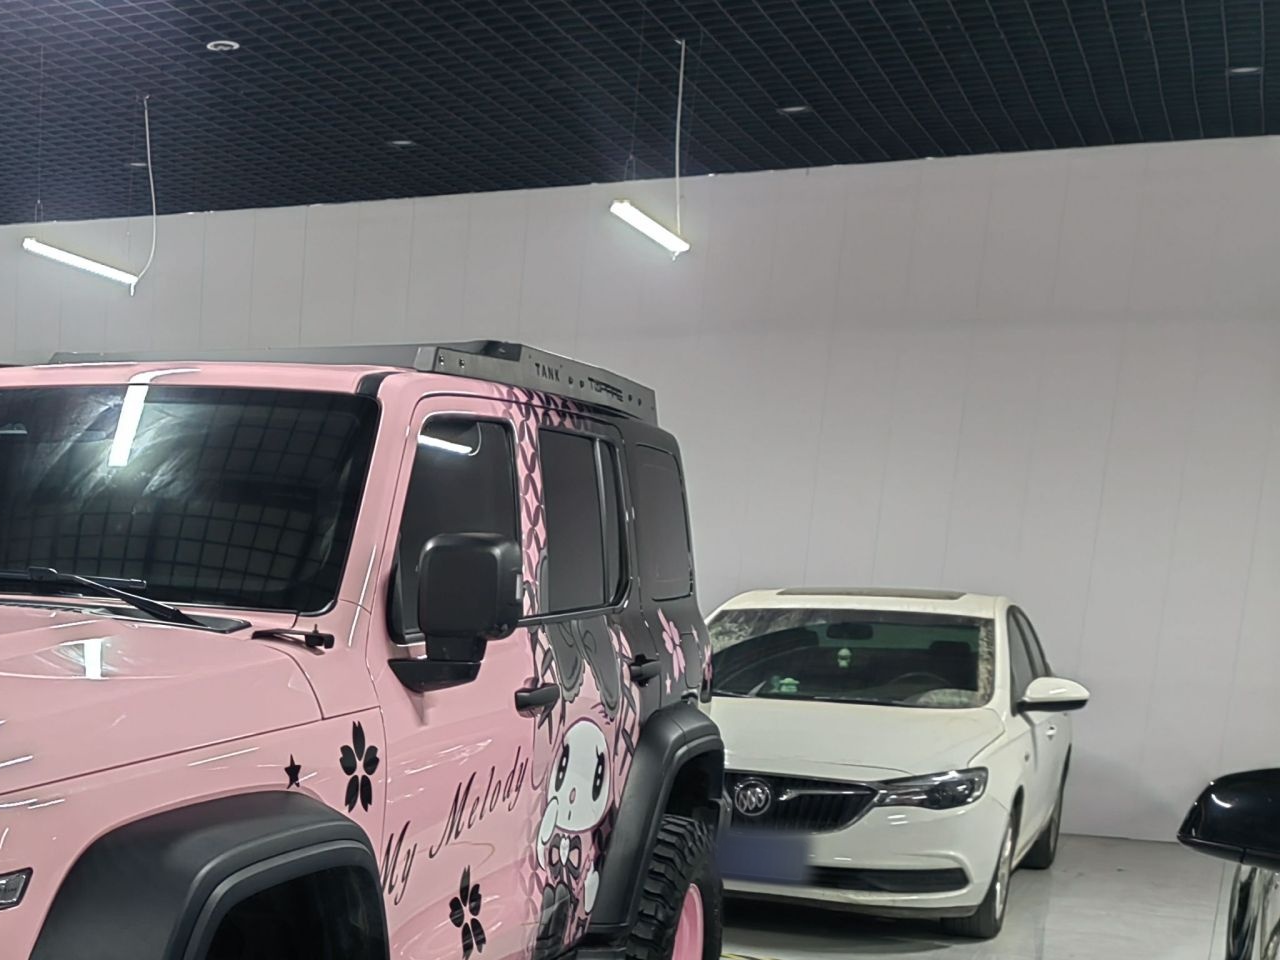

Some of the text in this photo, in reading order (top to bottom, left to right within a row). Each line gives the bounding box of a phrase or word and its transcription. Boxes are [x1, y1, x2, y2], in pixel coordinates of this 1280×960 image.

[535, 362, 560, 382] TANK
[380, 745, 529, 906] My Melody
